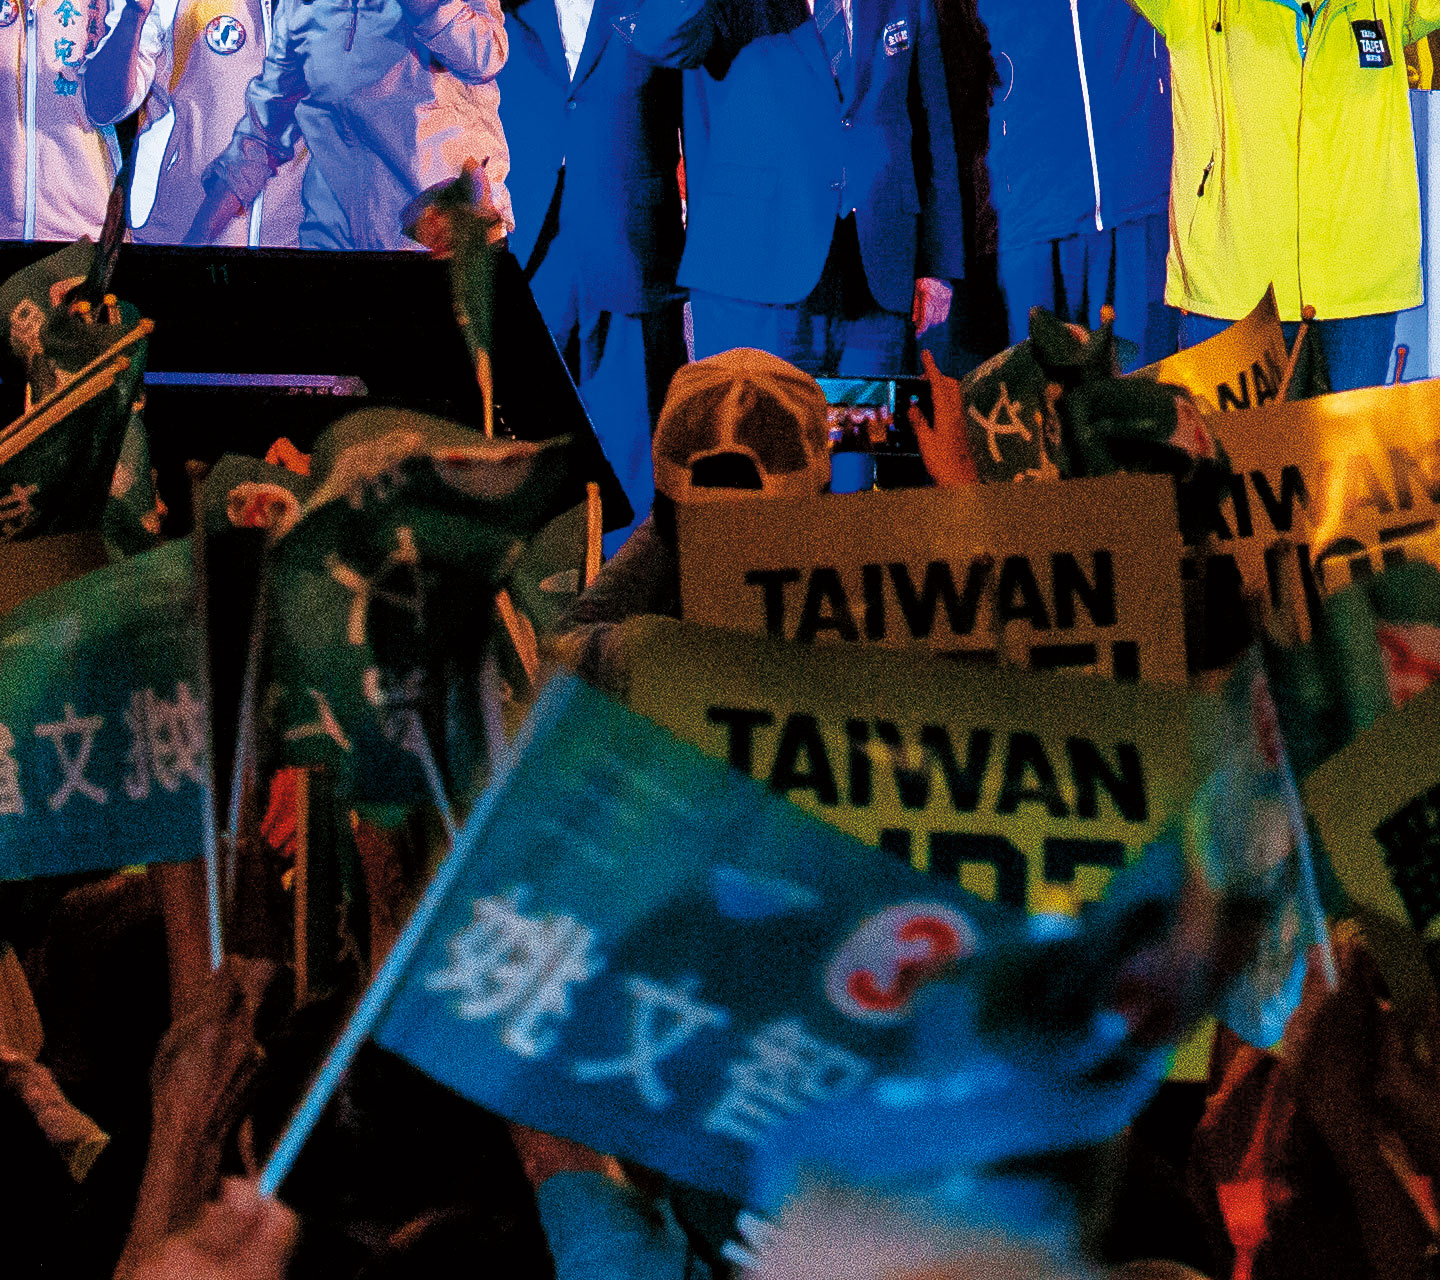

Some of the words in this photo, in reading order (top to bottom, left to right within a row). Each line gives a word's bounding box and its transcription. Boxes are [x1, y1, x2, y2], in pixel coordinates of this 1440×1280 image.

[747, 551, 1117, 643] TAIWAN
[707, 707, 1149, 823] TAIWAN
[426, 885, 874, 1141] 姚文智
[840, 907, 974, 1017] 3
